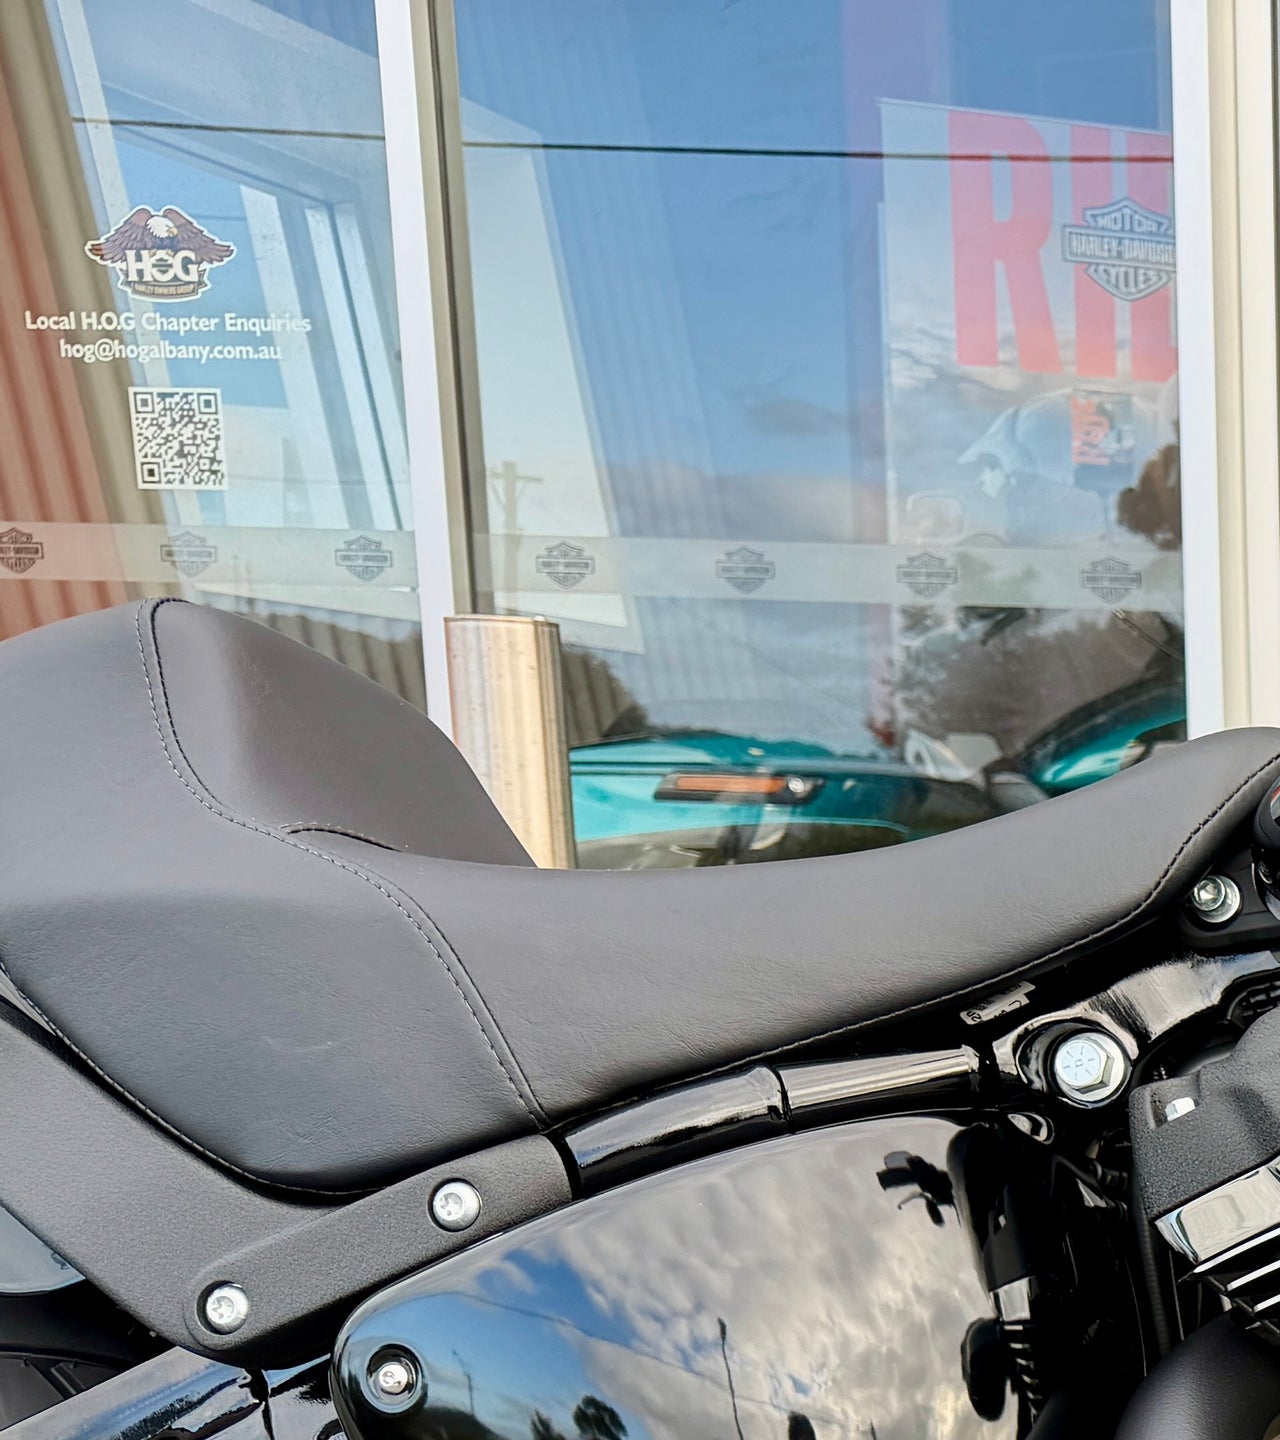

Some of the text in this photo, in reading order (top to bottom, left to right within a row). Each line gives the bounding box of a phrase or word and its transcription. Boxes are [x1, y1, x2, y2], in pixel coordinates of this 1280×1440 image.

[127, 250, 200, 283] HOG
[25, 311, 312, 337] Local H.O.G Chapter Enquiries
[60, 338, 282, 363] hog@hogalbany.com.au
